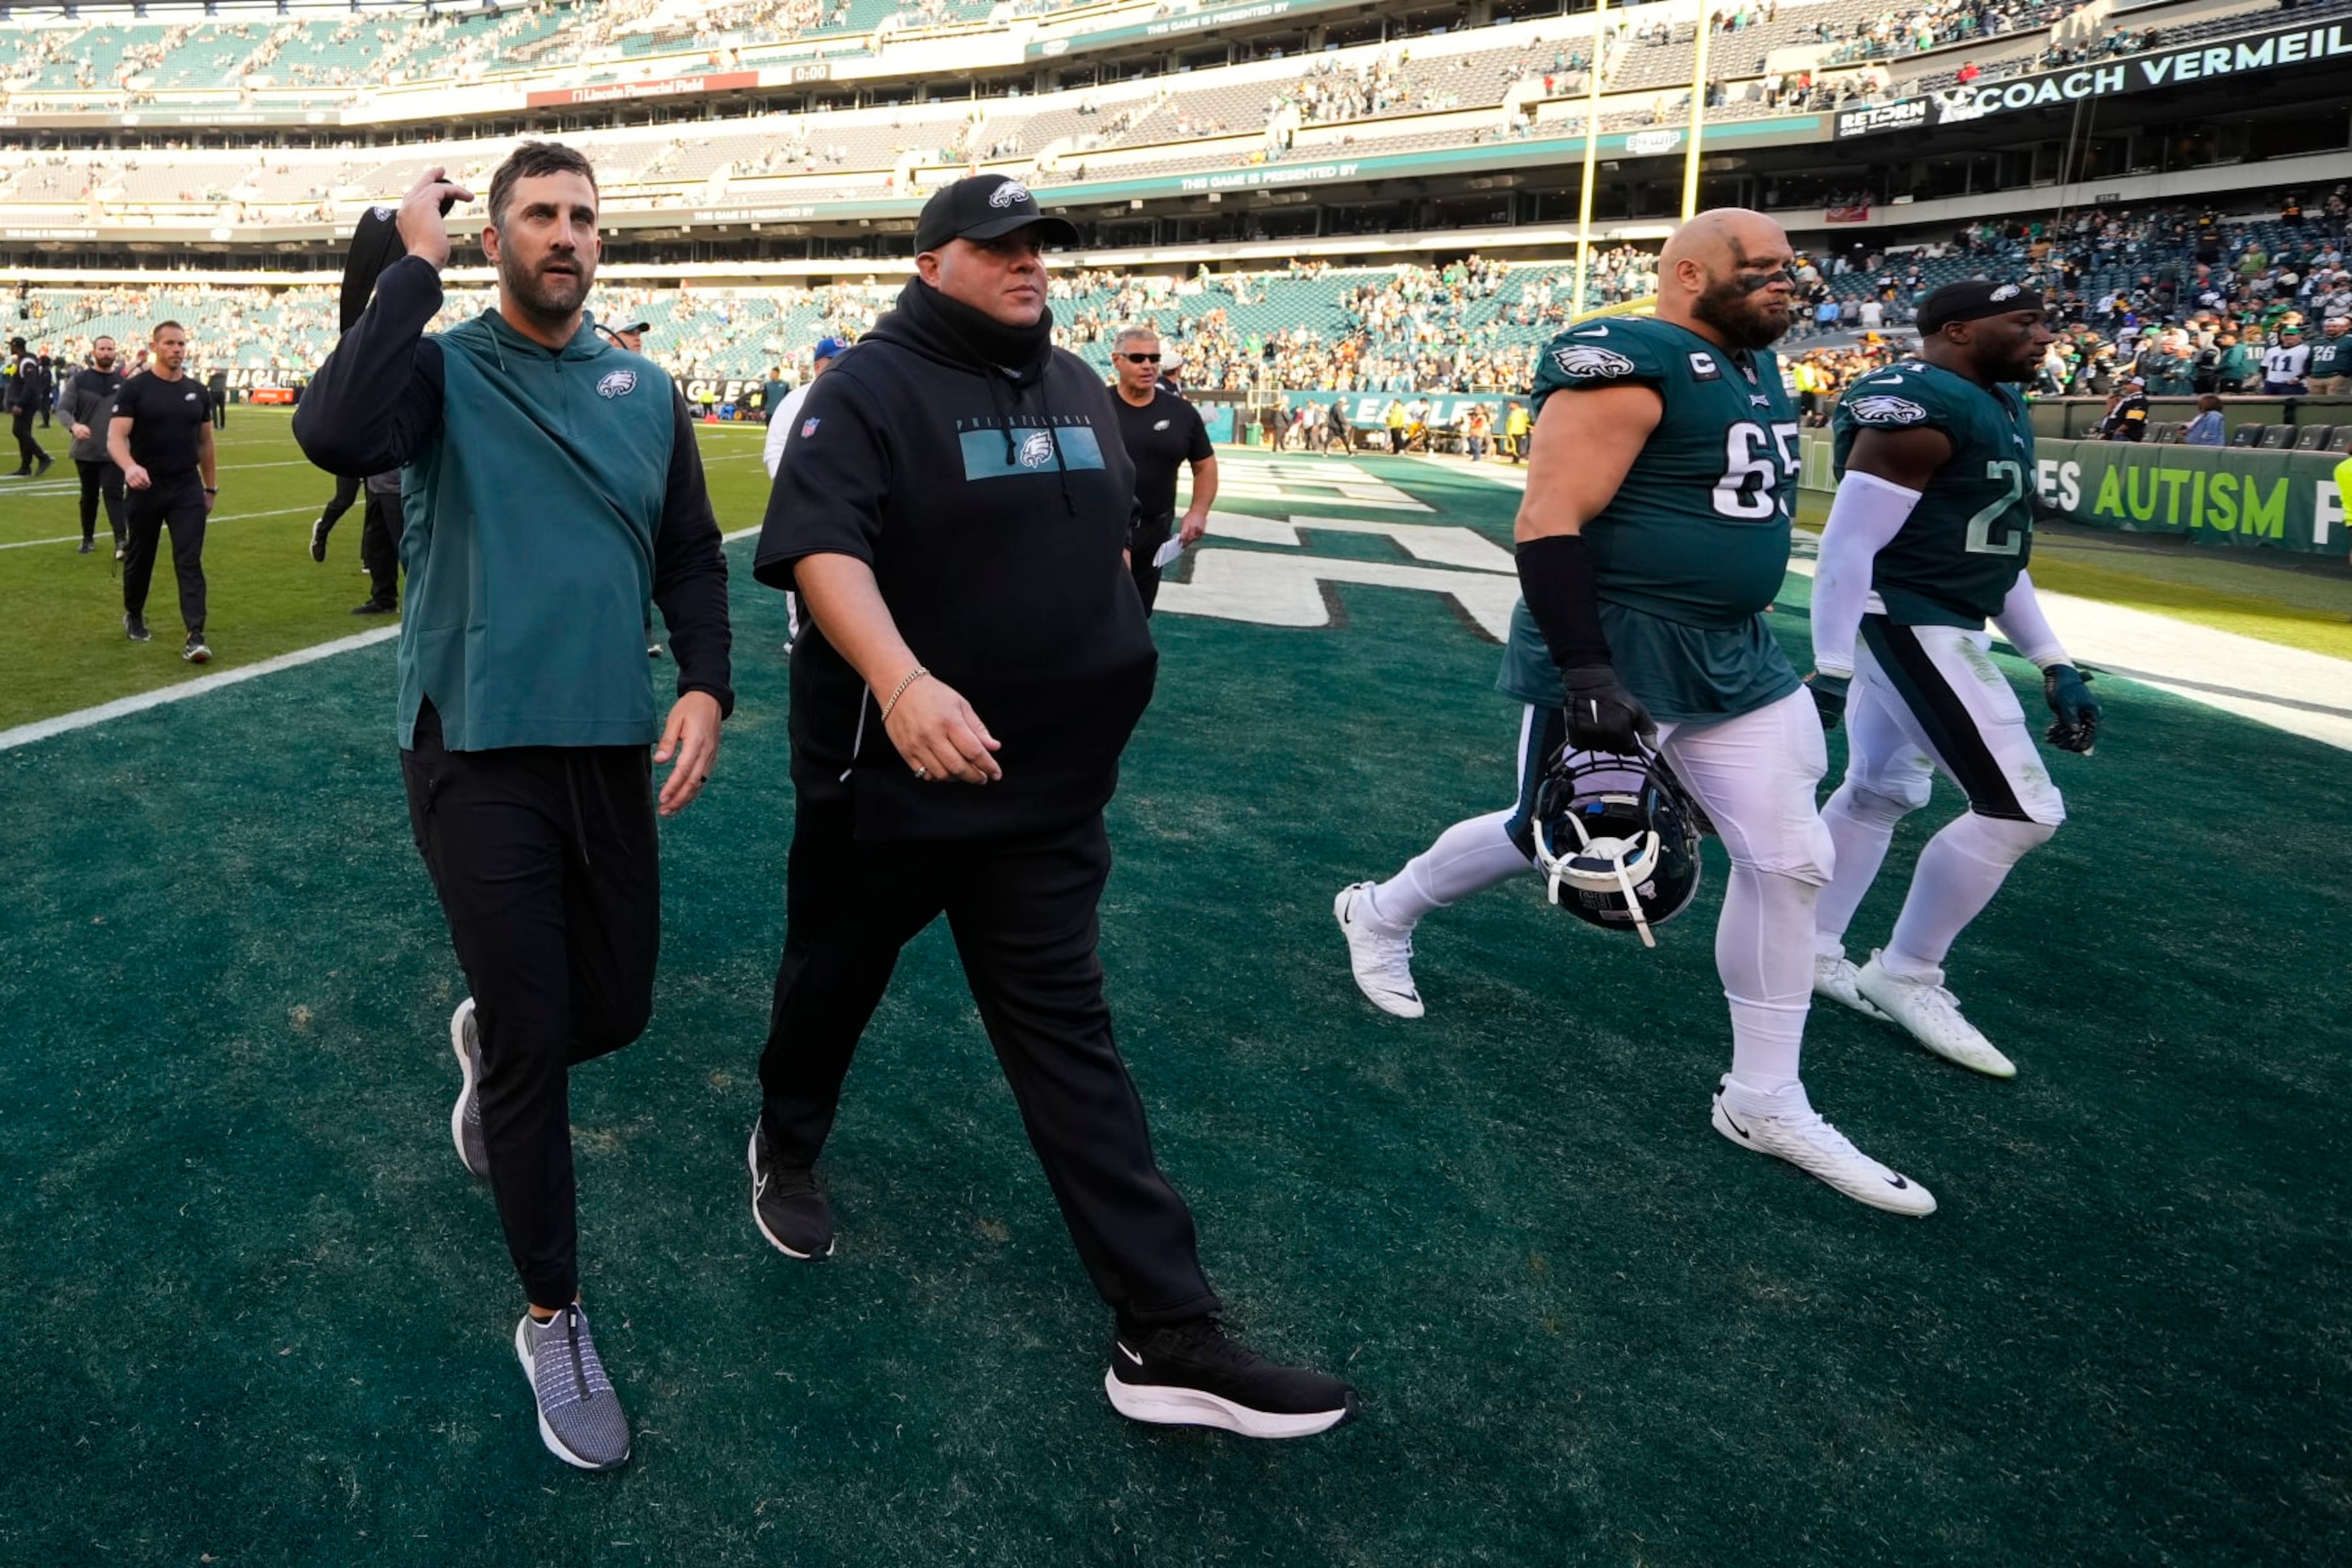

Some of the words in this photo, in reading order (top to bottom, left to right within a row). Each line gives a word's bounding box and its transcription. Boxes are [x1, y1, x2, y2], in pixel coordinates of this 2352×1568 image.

[1147, 24, 1169, 36] THIS
[1170, 18, 1199, 31] GAME
[1200, 16, 1211, 26] IS
[1213, 5, 1273, 24] PRESENTED
[1274, 2, 1289, 13] BY
[797, 66, 826, 81] 0:00
[1974, 65, 2125, 113] COACH
[2140, 26, 2352, 85] VERMEIL
[1181, 178, 1208, 190] THIS
[1210, 174, 1245, 188] GAME
[1247, 172, 1260, 184] IS
[1262, 165, 1336, 184] PRESENTED
[1339, 163, 1359, 176] BY
[1689, 352, 1716, 373] C
[2271, 355, 2293, 372] 11
[2093, 464, 2290, 538] AUTISM
